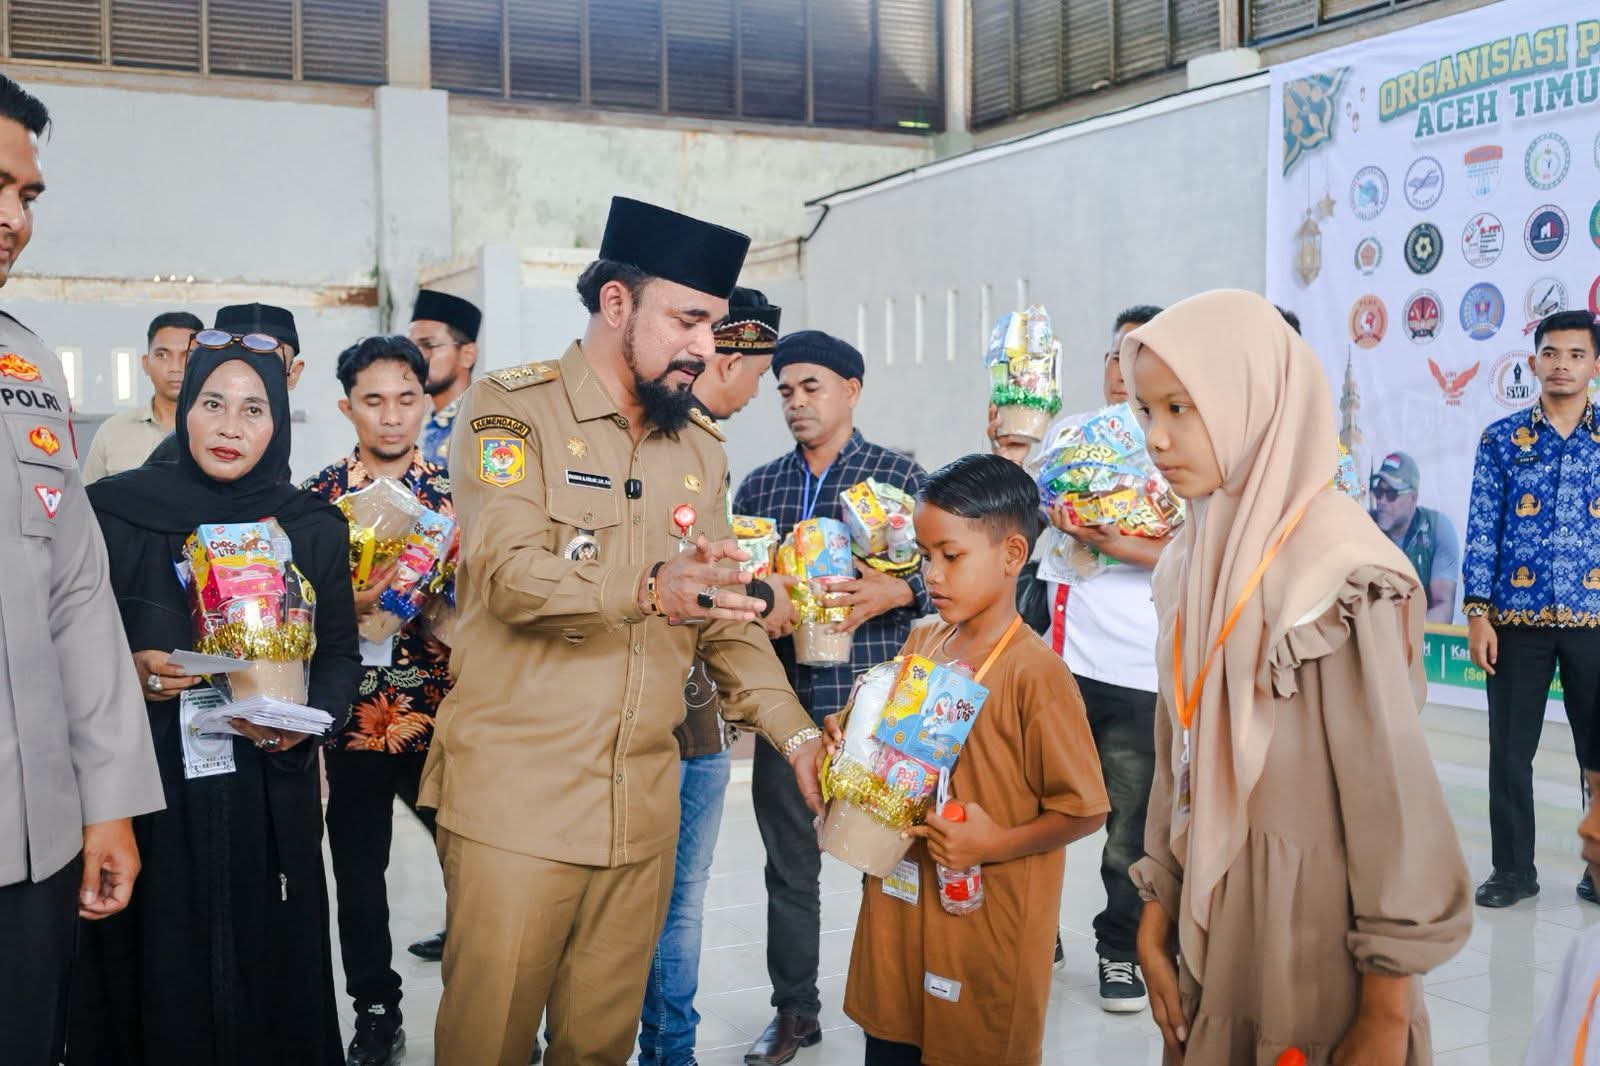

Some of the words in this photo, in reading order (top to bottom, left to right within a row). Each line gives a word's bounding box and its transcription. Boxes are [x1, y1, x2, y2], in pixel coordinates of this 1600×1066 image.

[1380, 24, 1568, 121] ORGANISASI
[1414, 89, 1498, 138] ACEH
[1, 388, 63, 412] POLRI
[1506, 385, 1529, 399] SWI
[475, 416, 526, 435] KEMENDAGRI
